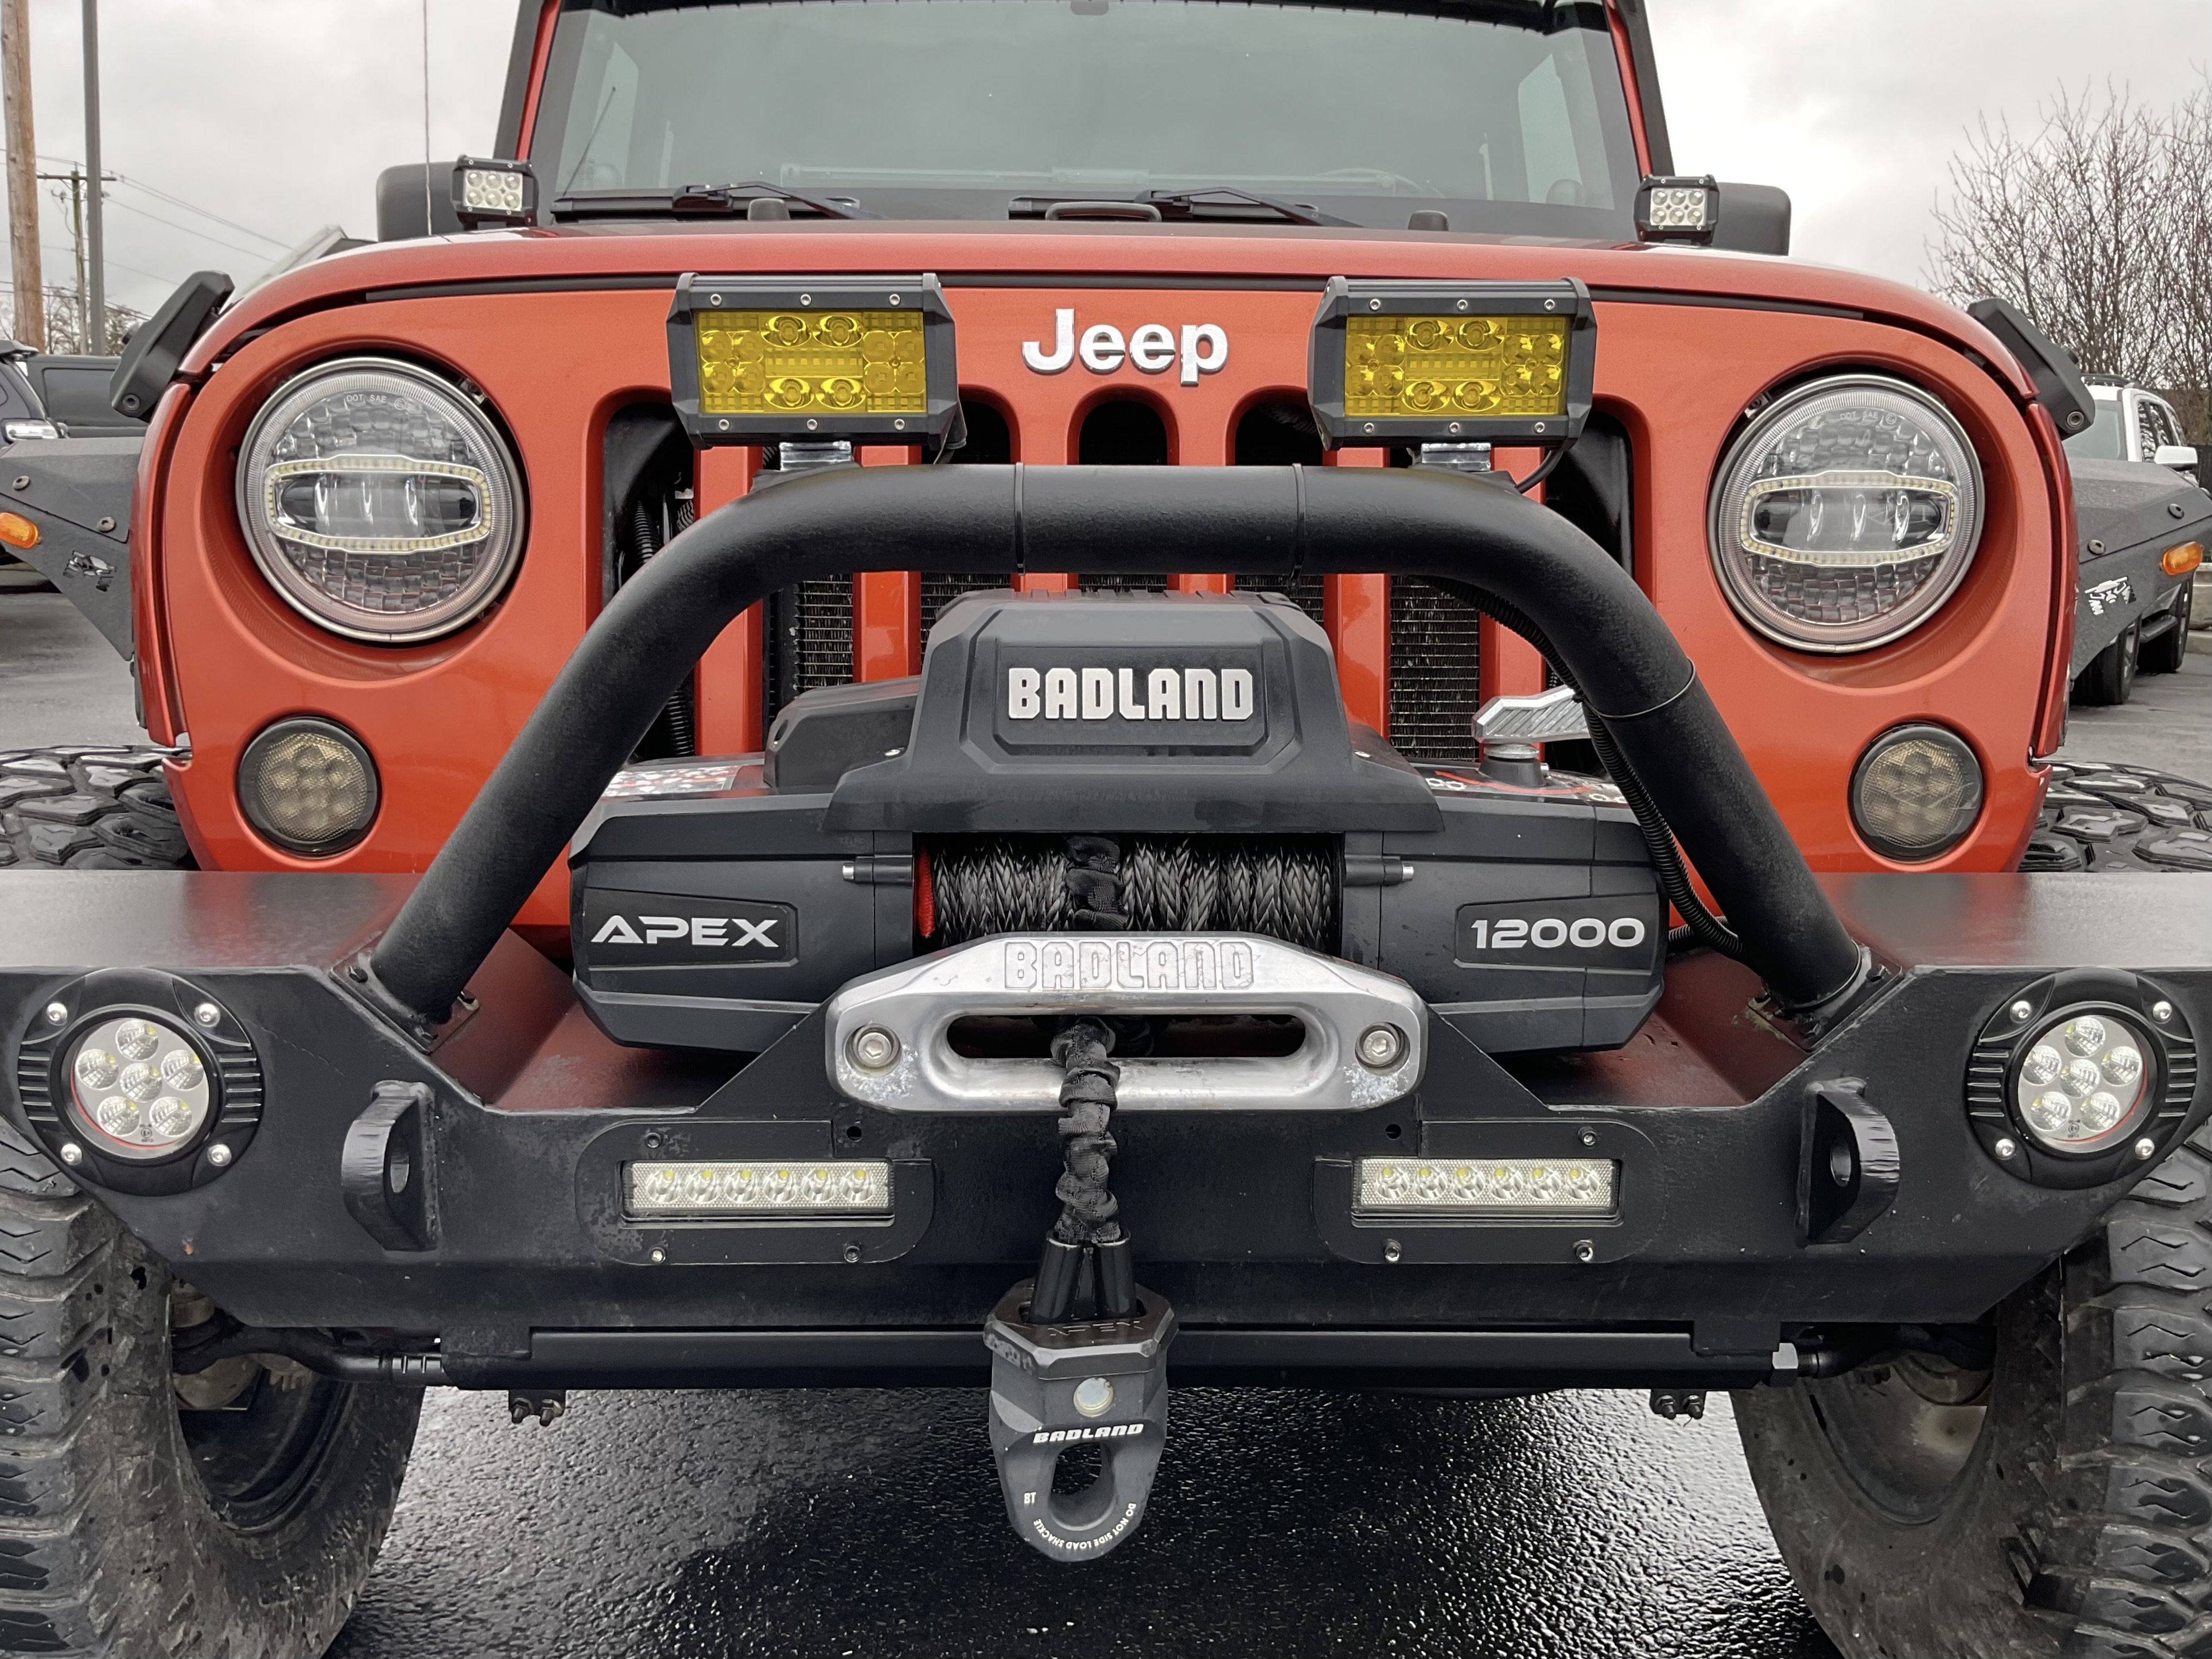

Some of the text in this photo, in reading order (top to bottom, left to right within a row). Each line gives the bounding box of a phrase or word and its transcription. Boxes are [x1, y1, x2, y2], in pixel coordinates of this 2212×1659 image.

[1022, 308, 1229, 387] Jeep
[347, 394, 387, 403] DOT SAE
[1008, 667, 1254, 721] BADLAND
[590, 915, 780, 947] APEX
[1471, 918, 1645, 949] 12000
[1004, 941, 1255, 990] BADLAND
[1033, 1423, 1144, 1443] BADLAND
[1033, 1503, 1137, 1550] DO NOT SIDE LOAD SHACKLE
